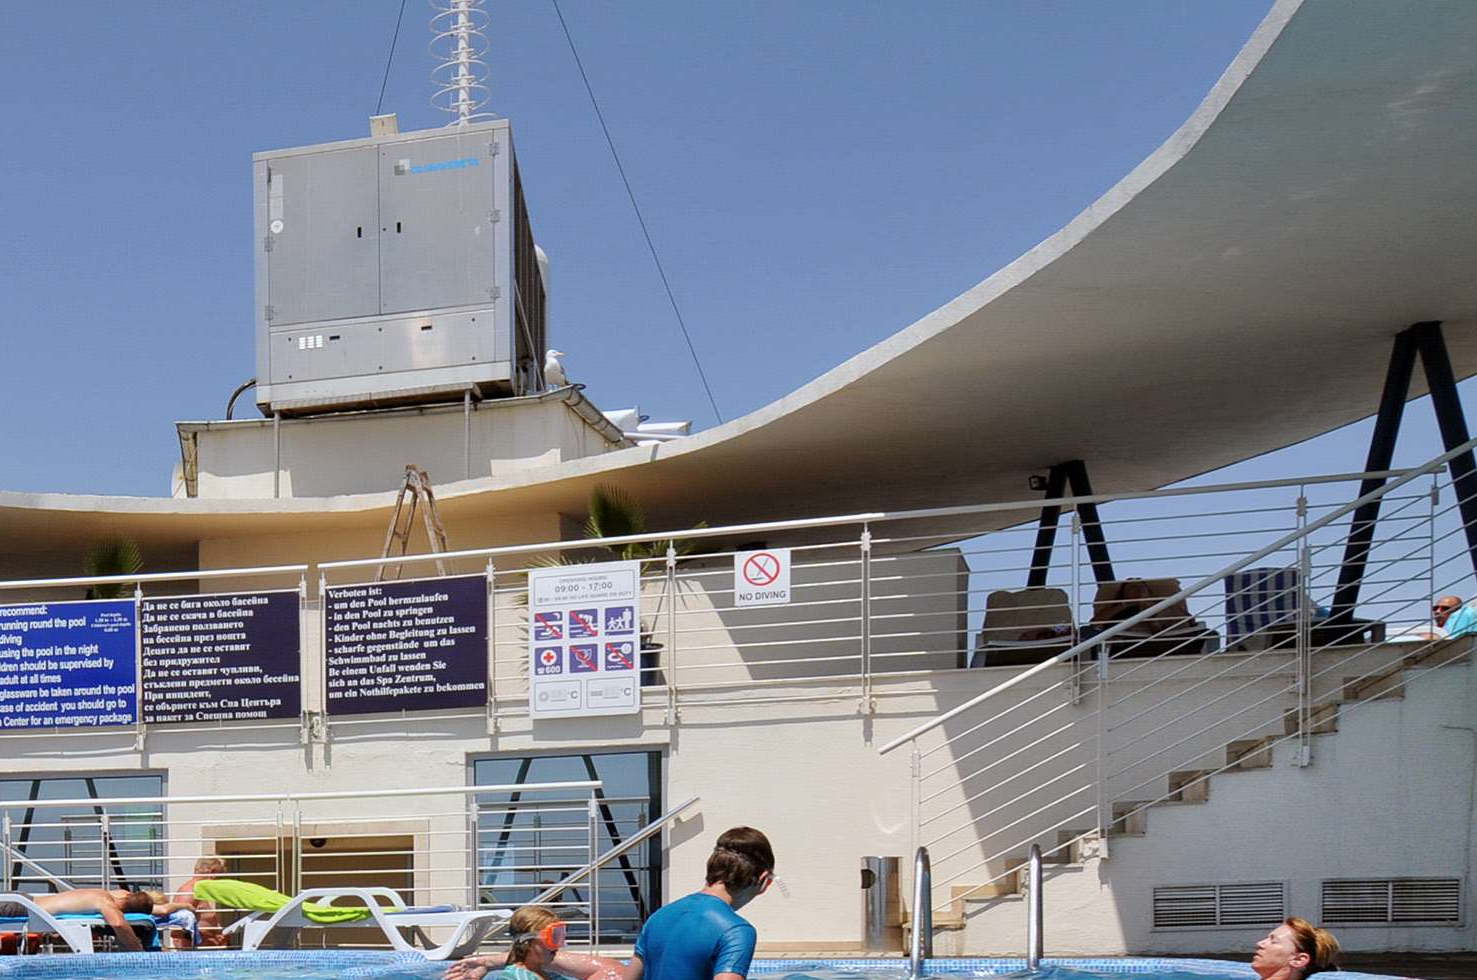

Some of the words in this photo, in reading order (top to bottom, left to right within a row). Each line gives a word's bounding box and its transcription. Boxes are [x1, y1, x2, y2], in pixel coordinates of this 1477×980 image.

[589, 582, 613, 591] 17:00
[755, 591, 786, 600] DIVING
[0, 606, 47, 616] recommend:
[29, 618, 52, 628] round
[54, 618, 67, 627] the
[68, 617, 85, 628] pool
[0, 647, 19, 659] using
[22, 646, 33, 656] the
[36, 646, 53, 657] pool
[55, 646, 62, 655] in
[64, 645, 76, 654] the
[78, 644, 98, 656] night
[20, 660, 45, 670] should
[48, 660, 57, 669] be
[59, 658, 101, 671] supervised
[103, 658, 113, 669] by
[0, 675, 18, 684] adult
[20, 674, 27, 684] at
[29, 674, 38, 683] all
[40, 673, 61, 683] times
[0, 688, 37, 700] glassware
[39, 687, 49, 696] be
[50, 686, 71, 696] taken
[74, 685, 101, 695] around
[103, 685, 115, 694] the
[117, 684, 134, 695] pool
[16, 702, 23, 711] of
[25, 701, 57, 711] accident
[60, 702, 76, 711] you
[77, 699, 104, 709] should
[106, 700, 116, 710] go
[118, 698, 126, 708] to
[3, 716, 29, 726] Center
[30, 715, 41, 725] for
[55, 715, 97, 725] emergency
[99, 712, 132, 724] package
